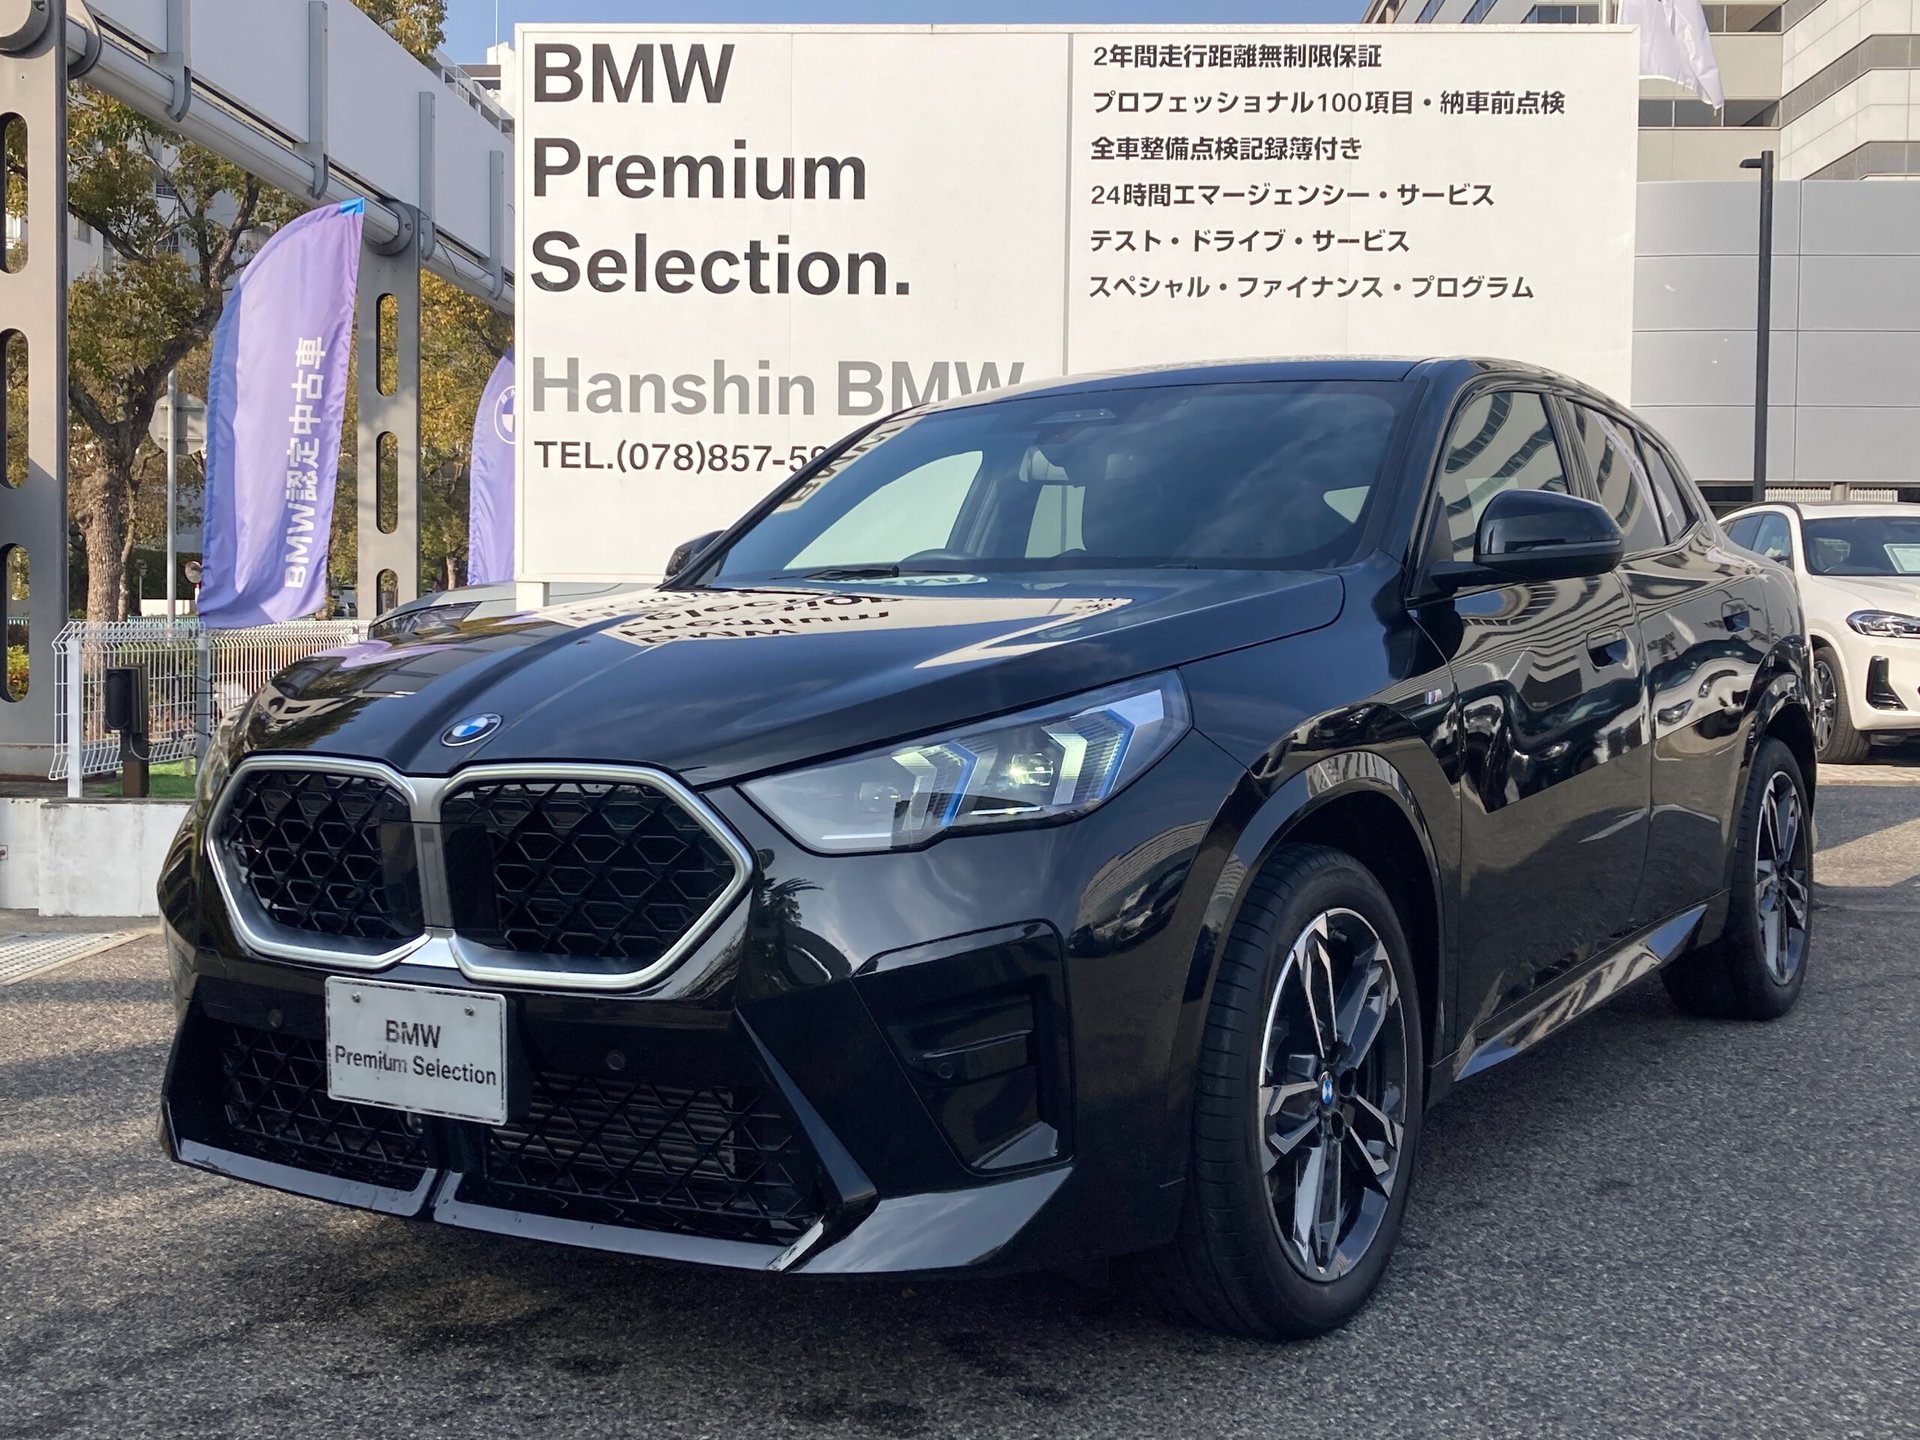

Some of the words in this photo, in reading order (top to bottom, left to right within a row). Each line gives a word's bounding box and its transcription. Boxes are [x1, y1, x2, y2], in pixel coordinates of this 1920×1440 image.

[1093, 44, 1382, 69] 2年間走行距離無制限保証
[535, 43, 735, 104] BMW
[1093, 89, 1566, 115] プロフェッショナル100項目・納車前点検
[1090, 136, 1362, 161] 全車整備点検記録簿付き
[534, 138, 866, 200] Premium
[1091, 182, 1495, 207] 24時間エマージェンシー・サービス
[1090, 229, 1410, 253] テスト・ドライブ・サービス
[531, 231, 910, 296] Selection.
[1089, 275, 1534, 299] スペシャル・ファイナンス・プログラム
[532, 357, 815, 416] Hanshin
[837, 360, 1025, 416] BMW
[284, 336, 327, 588] BMW認定中古車
[385, 1019, 441, 1049] BMW
[335, 1045, 408, 1073] Premium
[412, 1055, 497, 1086] Selection
